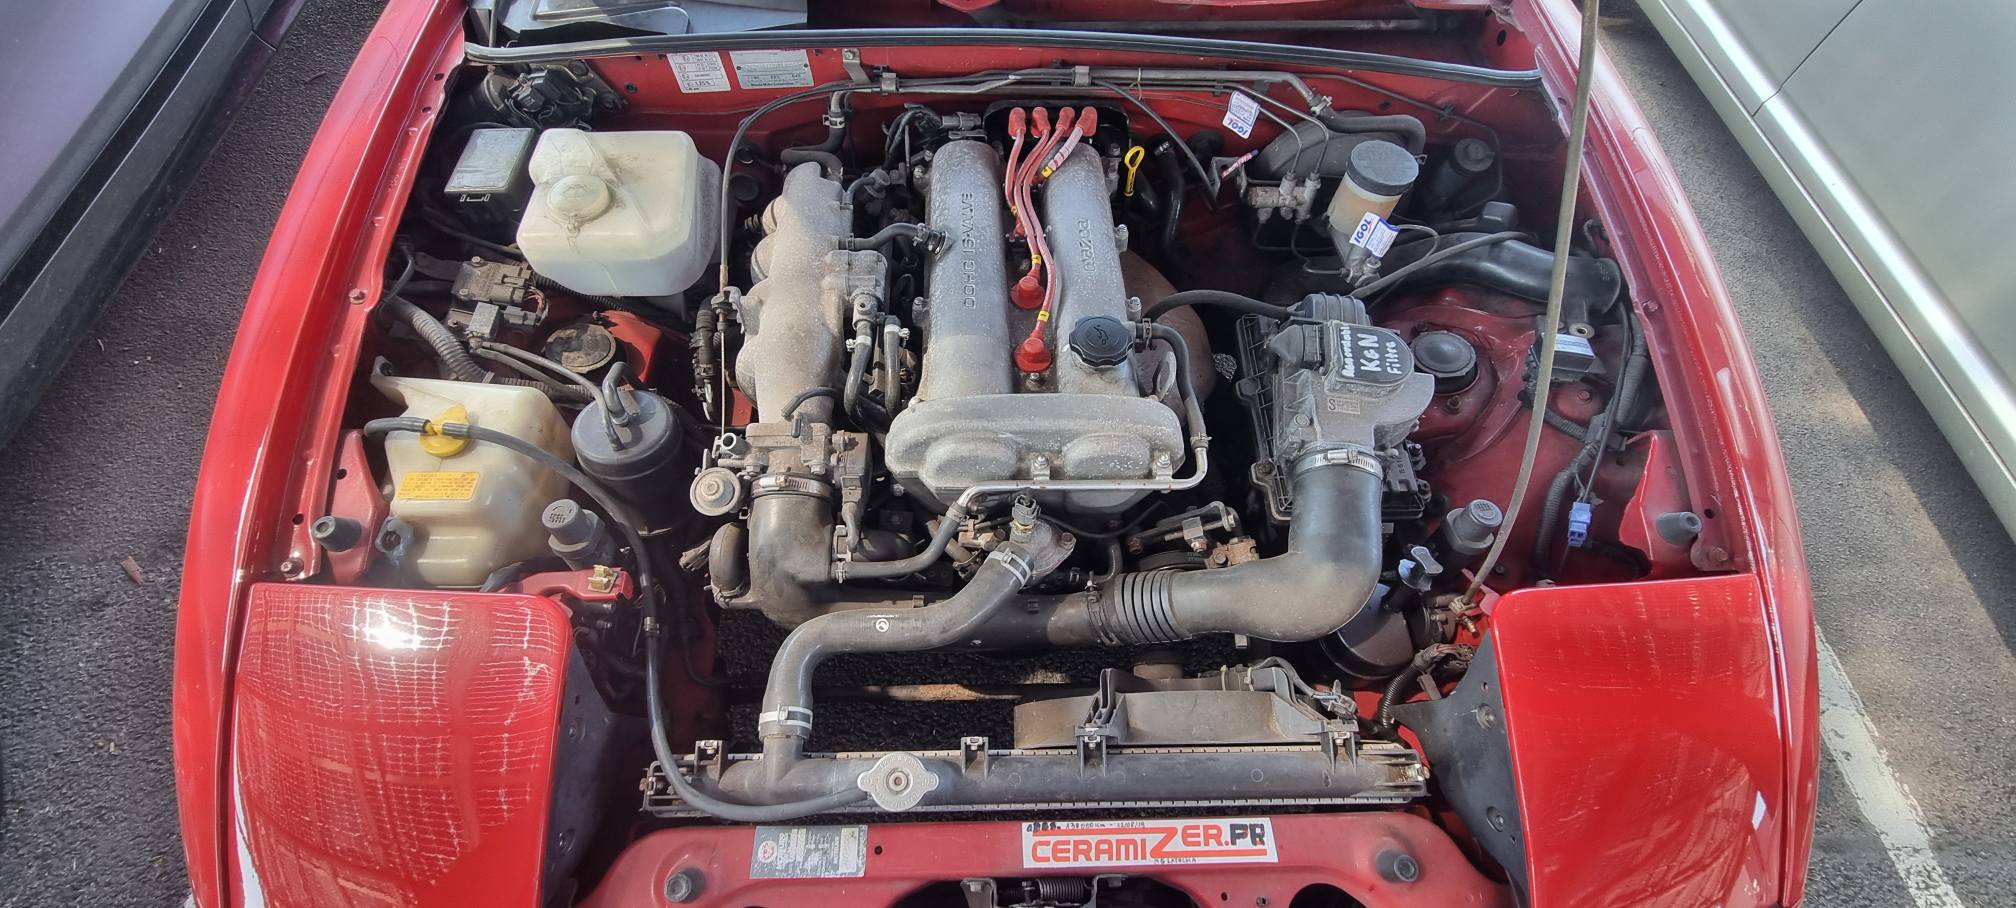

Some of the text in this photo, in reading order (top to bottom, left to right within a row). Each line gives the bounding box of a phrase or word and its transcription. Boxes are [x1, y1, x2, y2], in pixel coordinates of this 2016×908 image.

[1227, 118, 1248, 136] IGOL
[1354, 218, 1372, 244] IGOL
[962, 260, 976, 309] DOHC
